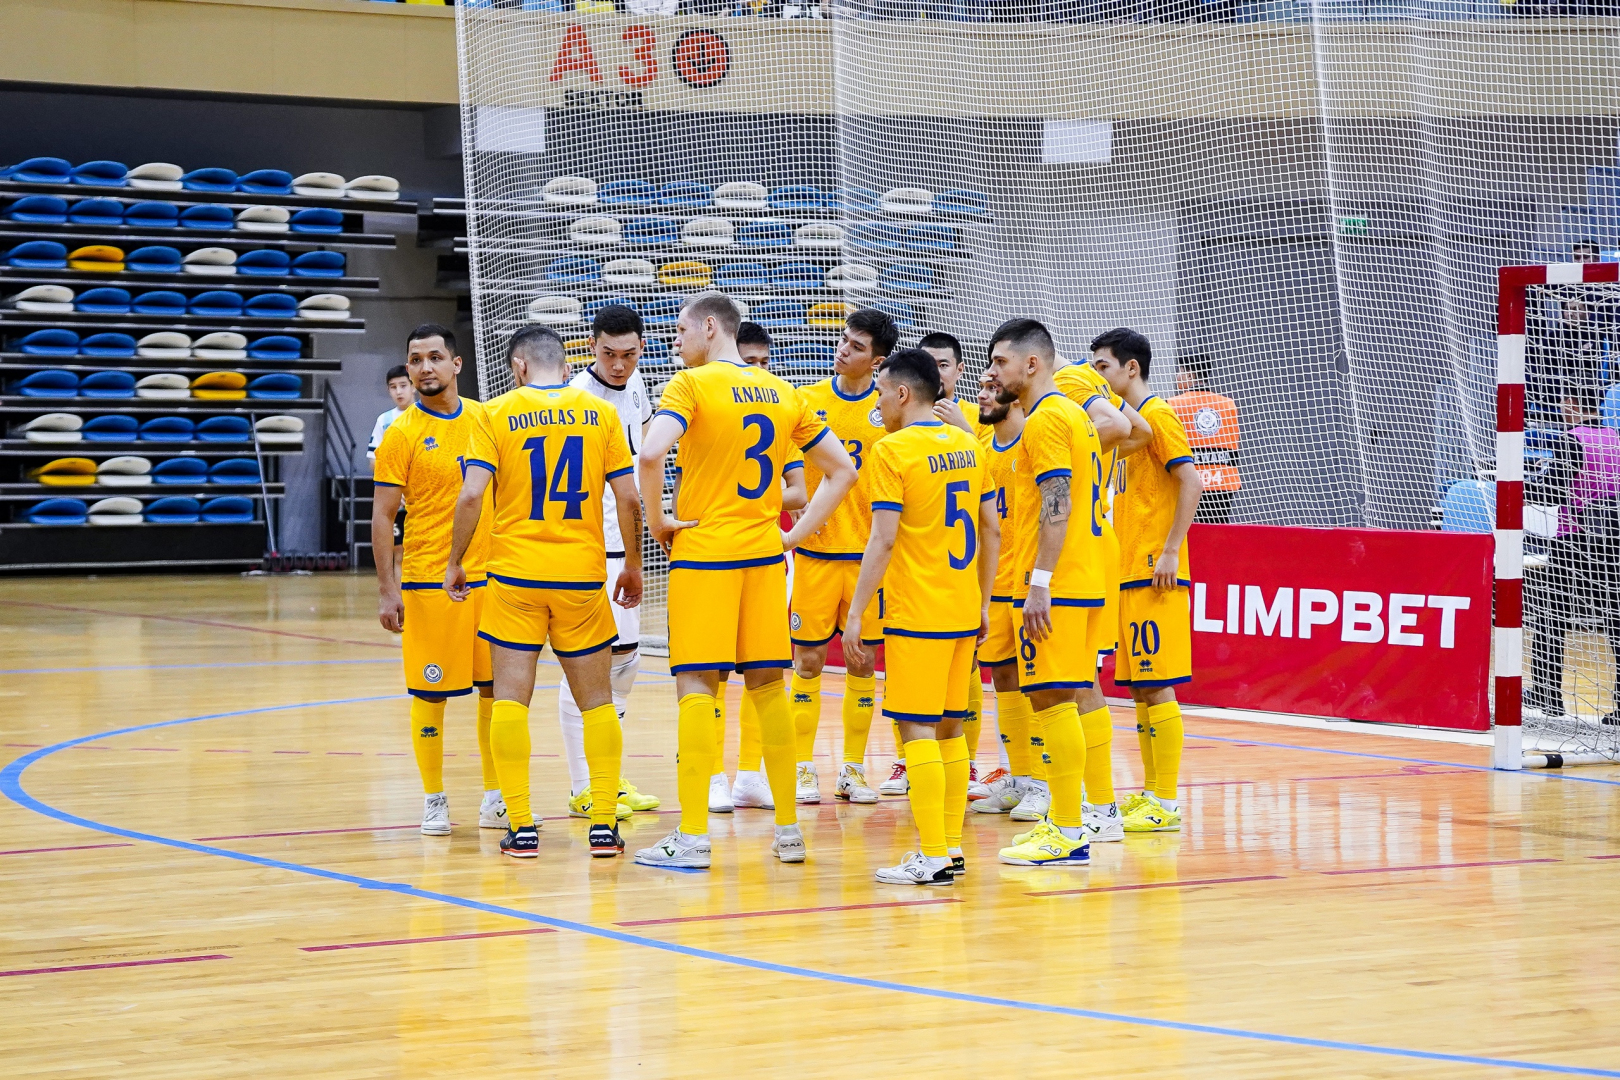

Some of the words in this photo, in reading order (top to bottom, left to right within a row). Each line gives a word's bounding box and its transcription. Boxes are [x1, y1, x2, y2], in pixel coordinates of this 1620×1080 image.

[732, 386, 779, 404] KNAUB
[508, 409, 575, 431] DOUGLAS
[582, 409, 599, 426] JR
[737, 413, 775, 500] 3
[840, 439, 863, 471] 3
[927, 449, 977, 474] DARIBAY
[521, 435, 590, 521] 14
[944, 480, 977, 571] 5
[1189, 582, 1471, 649] LIMPBET
[1018, 625, 1037, 662] 8
[1129, 619, 1161, 657] 20
